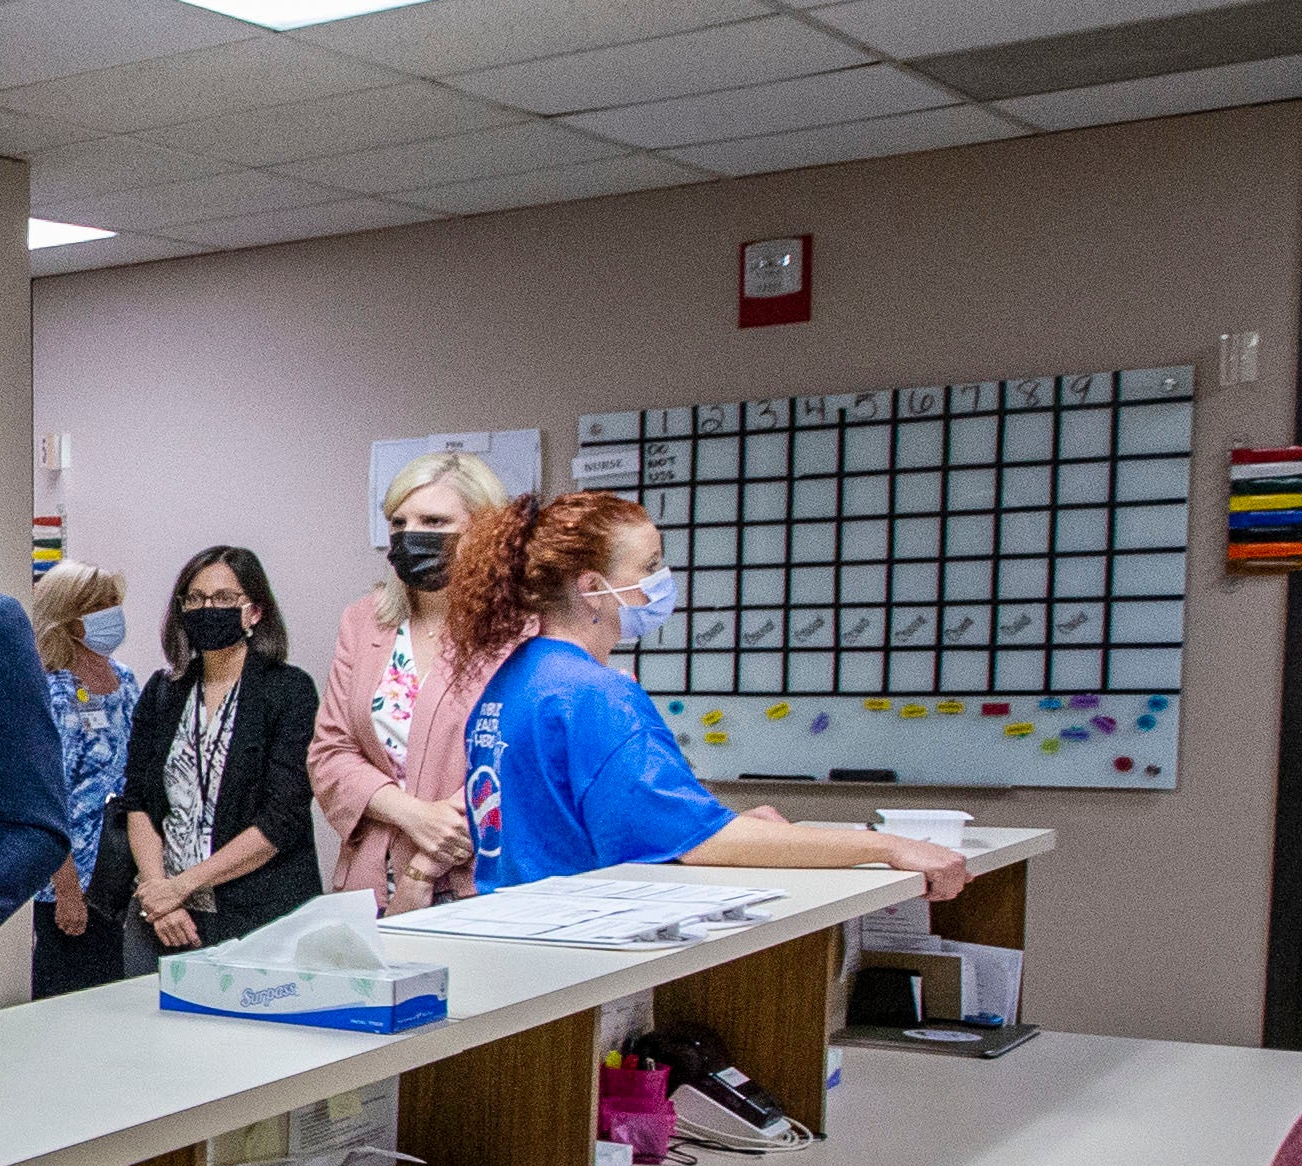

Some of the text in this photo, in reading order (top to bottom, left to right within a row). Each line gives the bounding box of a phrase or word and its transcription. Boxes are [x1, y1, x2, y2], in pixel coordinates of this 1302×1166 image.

[661, 375, 1094, 434] 1 2 3 4 5 6 7 8 9
[583, 457, 623, 473] NURSE
[239, 982, 298, 1008] Surpass
